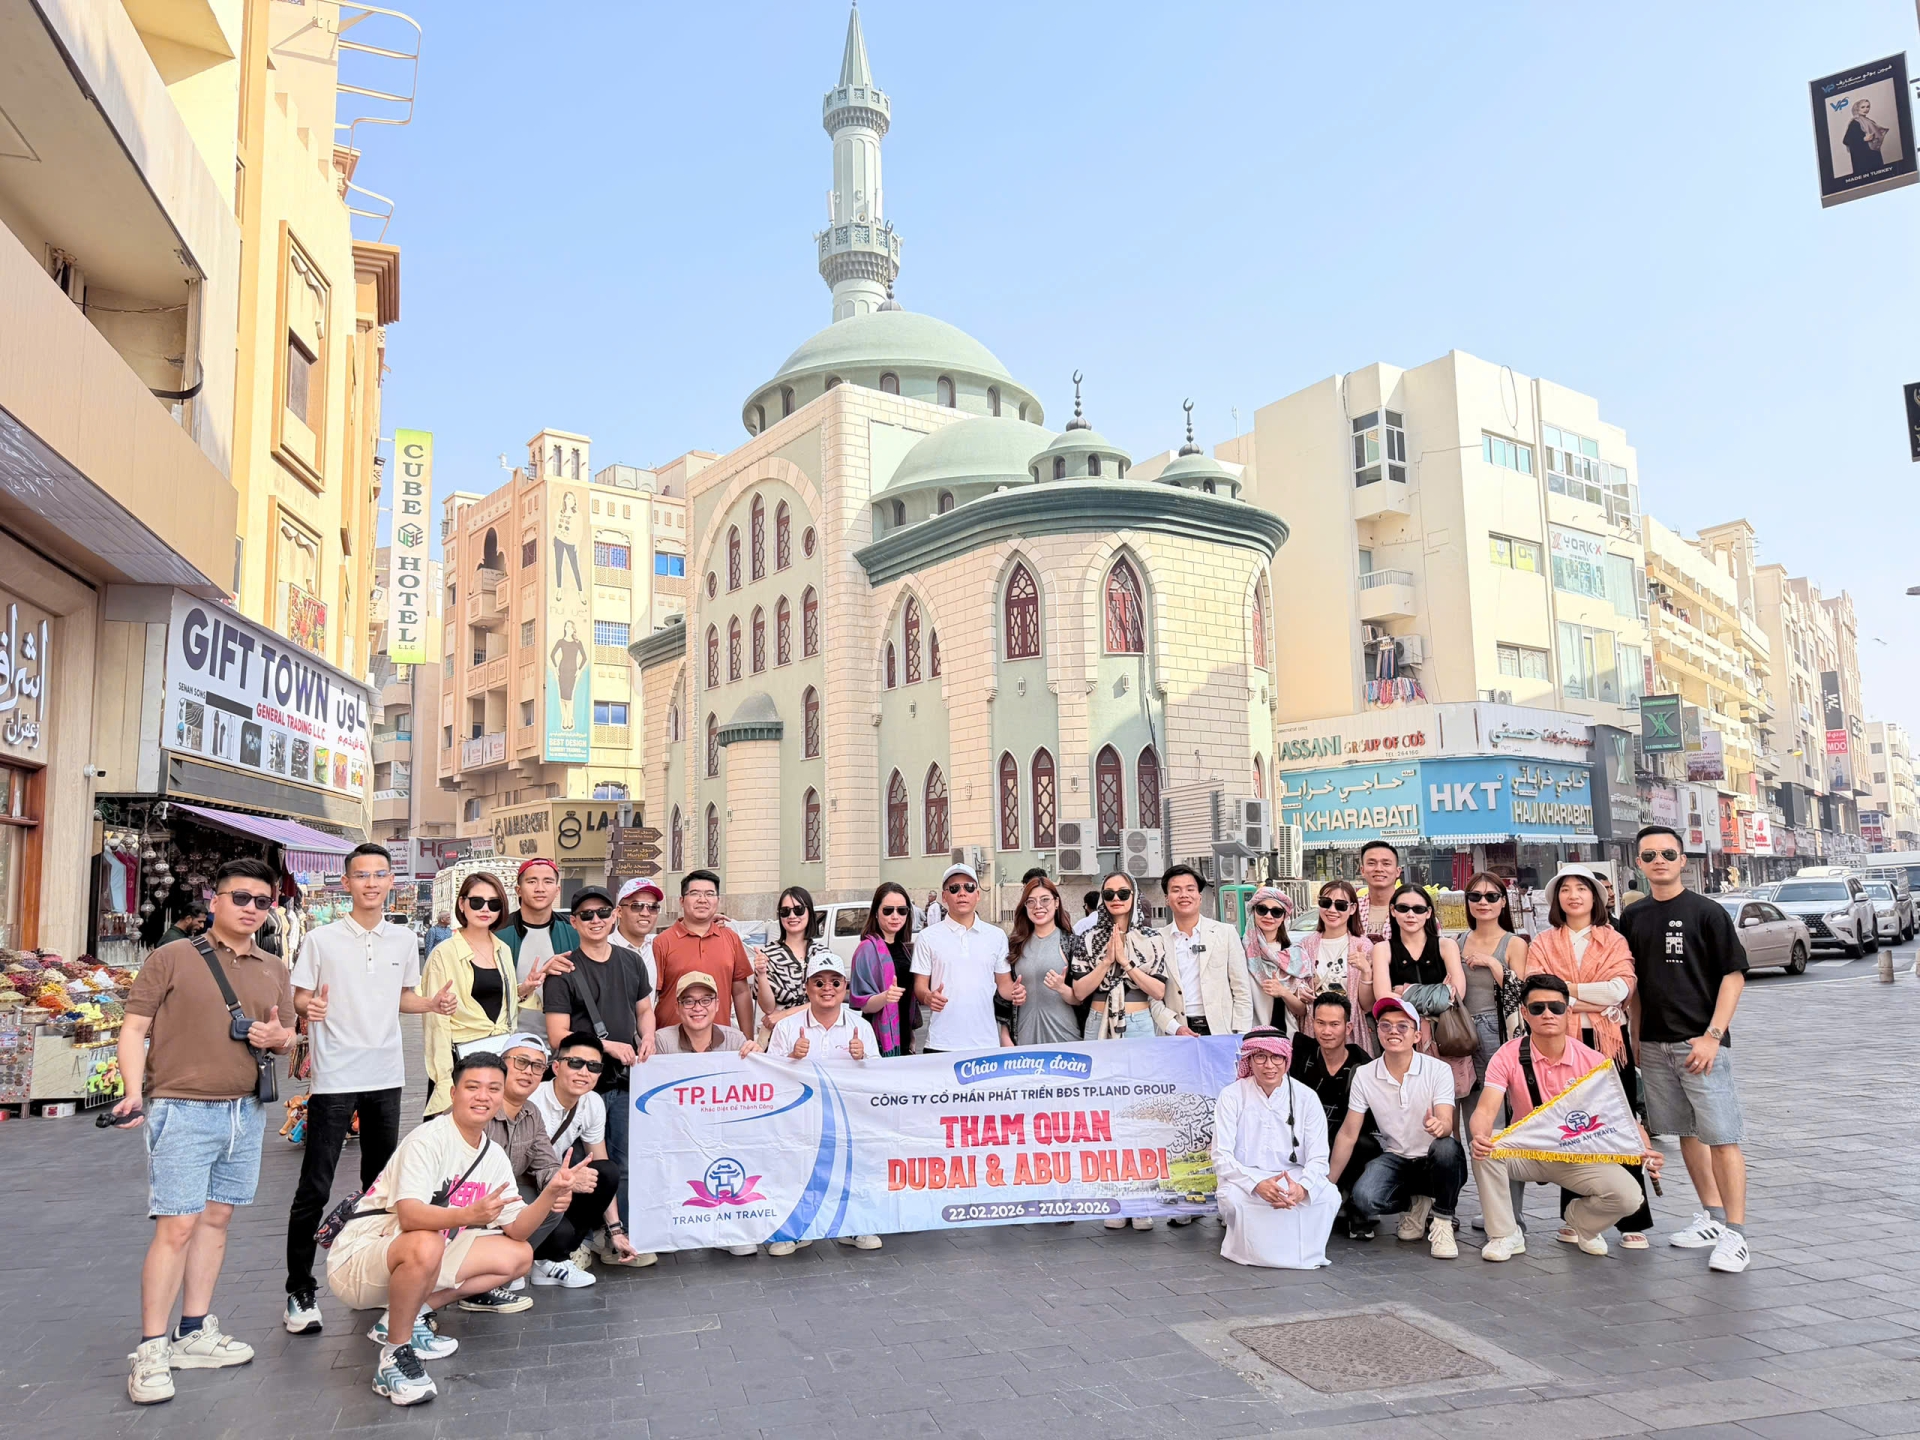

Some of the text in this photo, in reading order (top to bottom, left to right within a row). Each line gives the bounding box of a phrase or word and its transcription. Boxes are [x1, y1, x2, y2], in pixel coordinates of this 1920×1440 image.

[1845, 175, 1862, 183] MADE
[1870, 166, 1893, 176] TURKEY
[402, 444, 424, 516] CUBE
[1563, 536, 1602, 556] YORK-X
[397, 556, 422, 643] HOTEL
[182, 607, 330, 723] GIFT TOWN
[3, 708, 40, 750] زعفران
[256, 702, 285, 726] GENERAL
[286, 714, 313, 736] TRADING
[1383, 736, 1399, 749] OF
[1828, 742, 1847, 750] MDO
[1338, 772, 1405, 803] حاجي
[1430, 781, 1501, 812] HKT
[1556, 770, 1585, 797] حاجي
[1303, 803, 1418, 832] KHARABATI
[1513, 801, 1539, 824] HAJI
[1540, 802, 1594, 825] KHARABATI
[960, 1054, 1088, 1079] Chào mừng đoàn
[870, 1093, 909, 1107] CÔNG
[911, 1094, 927, 1104] TY
[930, 1089, 950, 1104] CỔ
[988, 1086, 1018, 1102] PHÁT
[1021, 1084, 1053, 1099] TRIỂN
[1056, 1086, 1080, 1098] BĐS
[1084, 1085, 1131, 1097] TP.LAND
[1133, 1084, 1176, 1095] GROUP
[940, 1112, 1026, 1148] THAM
[1033, 1109, 1113, 1146] QUAN
[1559, 1127, 1618, 1147] TRANG AN TRAVEL
[887, 1148, 1170, 1191] DUBAI & ABU DHABI
[672, 1208, 777, 1226] TRANG AN TRAVEL
[948, 1204, 1025, 1220] 22.02.2026
[1038, 1201, 1111, 1216] 27.02.2026
